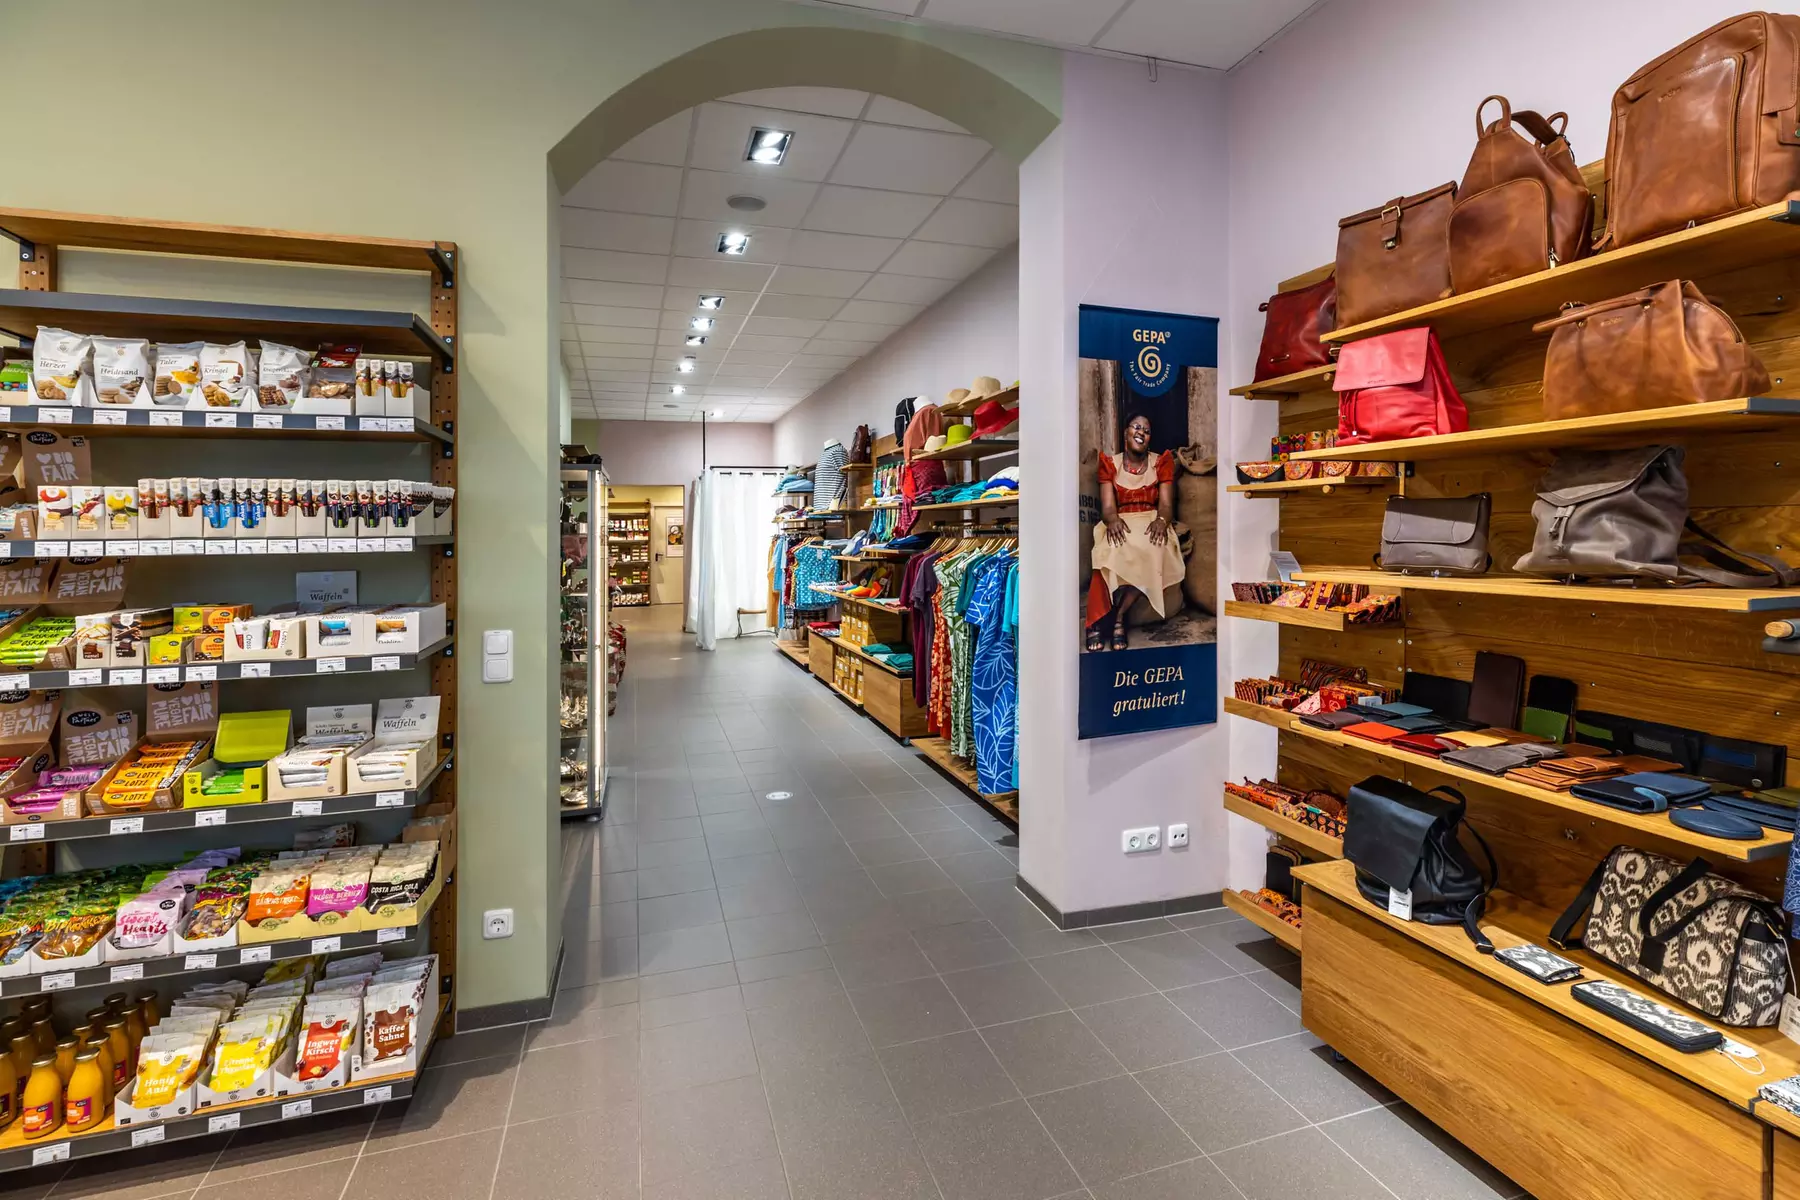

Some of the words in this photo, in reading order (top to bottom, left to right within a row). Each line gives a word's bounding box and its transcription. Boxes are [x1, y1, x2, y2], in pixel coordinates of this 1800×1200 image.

[39, 360, 67, 369] Herzen
[100, 367, 139, 376] Heidesand
[310, 592, 343, 602] Waffeln
[1113, 671, 1139, 688] Die
[1144, 665, 1184, 684] GEPA
[1112, 689, 1186, 717] gratuliert!
[383, 718, 416, 729] Waffeln
[370, 886, 389, 894] COSTA
[122, 920, 168, 935] Hearts
[378, 1024, 405, 1035] Kaffee
[378, 1032, 404, 1043] Sahne
[308, 1038, 339, 1048] Ingwer
[306, 1046, 334, 1056] Kirsch
[144, 1076, 176, 1087] Honig
[145, 1086, 169, 1095] Anis
